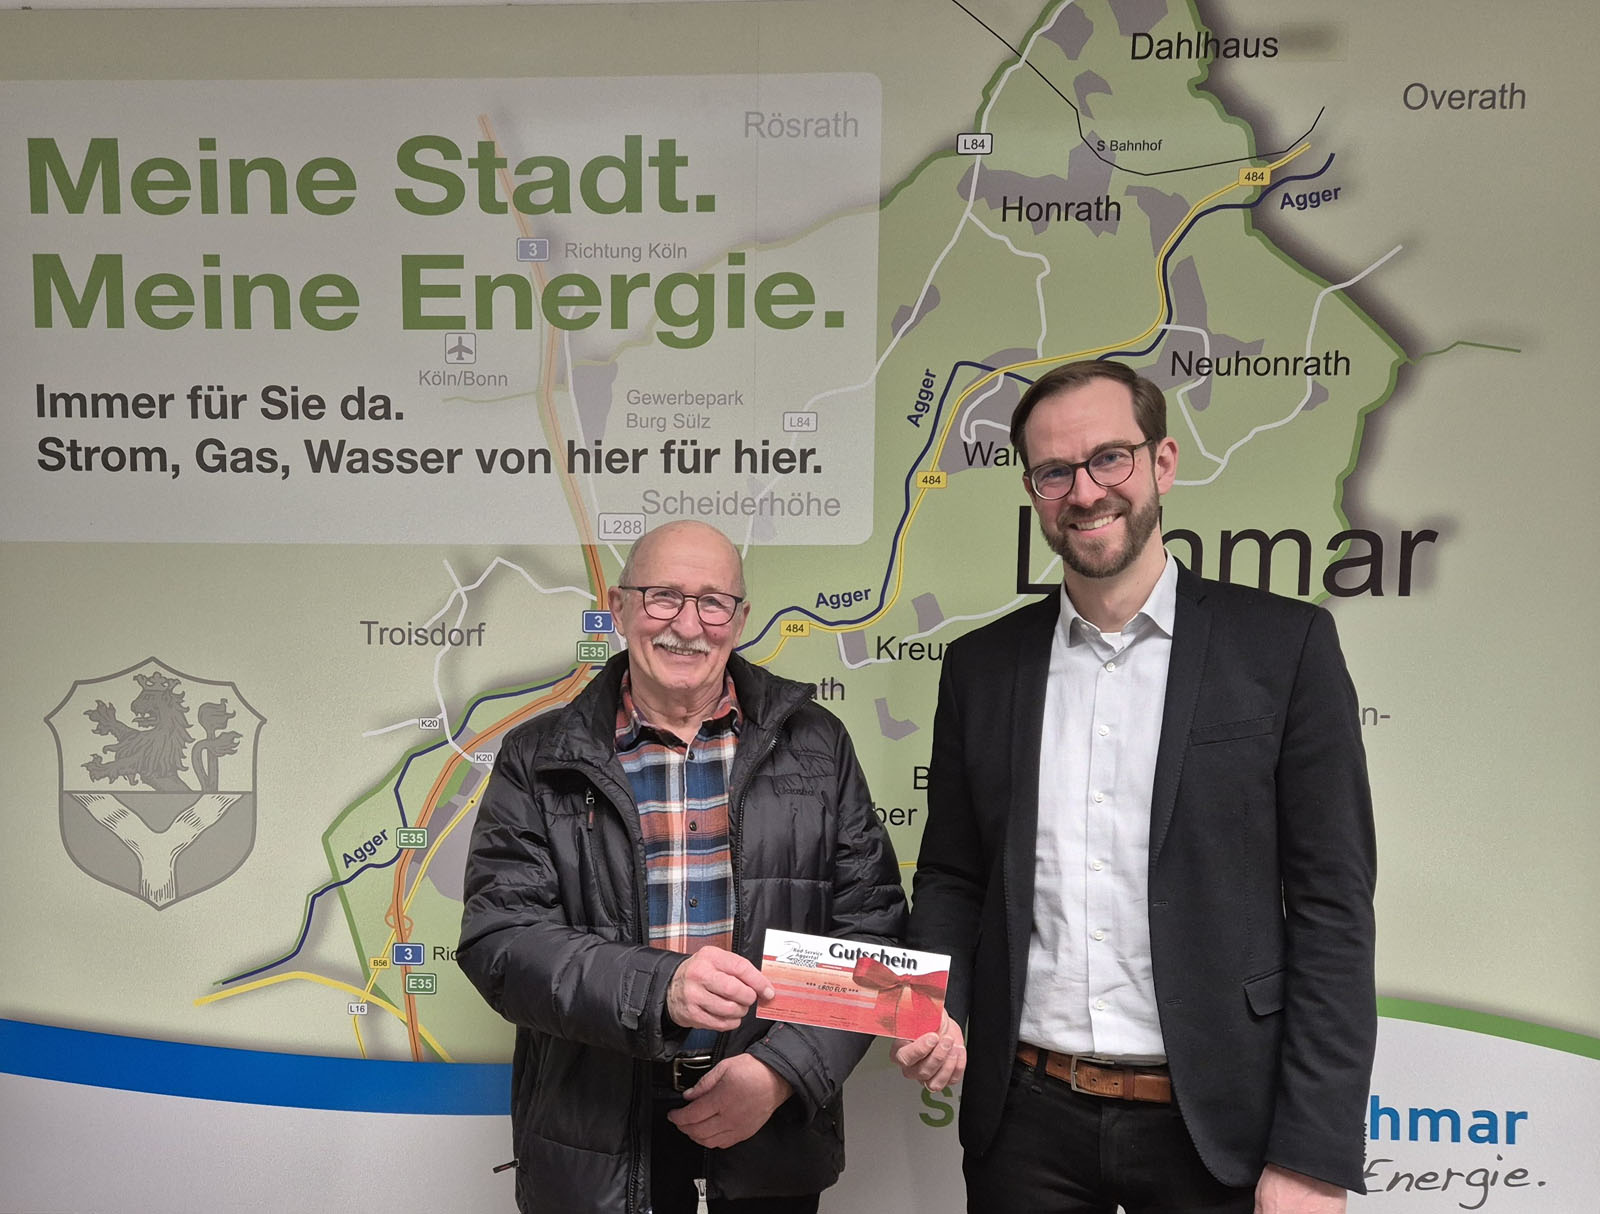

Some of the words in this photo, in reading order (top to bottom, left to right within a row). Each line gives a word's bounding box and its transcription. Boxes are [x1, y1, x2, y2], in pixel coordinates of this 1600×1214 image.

[1130, 32, 1279, 60] Dahlhaus
[1402, 82, 1527, 110] Overath
[744, 111, 859, 138] Rösrath
[963, 138, 986, 150] L84
[1097, 140, 1106, 152] S
[1110, 139, 1163, 152] Bahnhof
[27, 138, 357, 216] Meine
[395, 135, 716, 216] Stadt.
[1244, 171, 1265, 183] 484
[1280, 184, 1342, 211] Agger
[1002, 196, 1121, 223] Honrath
[528, 242, 538, 257] 3
[565, 242, 642, 262] Richtung
[648, 242, 687, 259] Köln
[32, 253, 360, 331] Meine
[401, 252, 845, 350] Energie.
[1171, 350, 1351, 377] Neuhonrath
[418, 369, 508, 388] Köln/Bonn
[36, 384, 174, 419] Immer
[187, 386, 247, 420] für
[260, 385, 326, 421] Sie
[340, 387, 405, 421] da.
[626, 389, 744, 408] Gewerbepark
[906, 368, 937, 429] Agger
[627, 412, 667, 433] Burg
[673, 411, 711, 430] Sülz
[790, 416, 811, 429] L84
[37, 437, 181, 480] Strom,
[195, 438, 291, 480] Gas,
[304, 440, 463, 474] Wasser
[476, 448, 552, 474] von
[567, 441, 646, 474] hier
[660, 441, 721, 474] für
[734, 440, 823, 474] hier.
[963, 441, 1019, 466] Wa
[921, 475, 942, 485] 484
[641, 490, 842, 517] Scheiderhöhe
[603, 518, 642, 536] L288
[1016, 505, 1439, 597] Lhmar
[815, 588, 872, 609] Agger
[594, 616, 604, 629] 3
[785, 623, 805, 634] 484
[360, 620, 486, 647] Troisdorf
[581, 647, 605, 658] E35
[876, 636, 950, 661] Kreu
[421, 719, 438, 729] K20
[476, 753, 493, 763] K20
[342, 828, 389, 869] Agger
[400, 832, 424, 844] E35
[373, 958, 388, 968] B56
[404, 948, 413, 960] 3
[829, 942, 918, 970] Gutschein
[409, 978, 432, 990] E35
[349, 1003, 365, 1013] L16
[1364, 1153, 1546, 1210] Energie.
